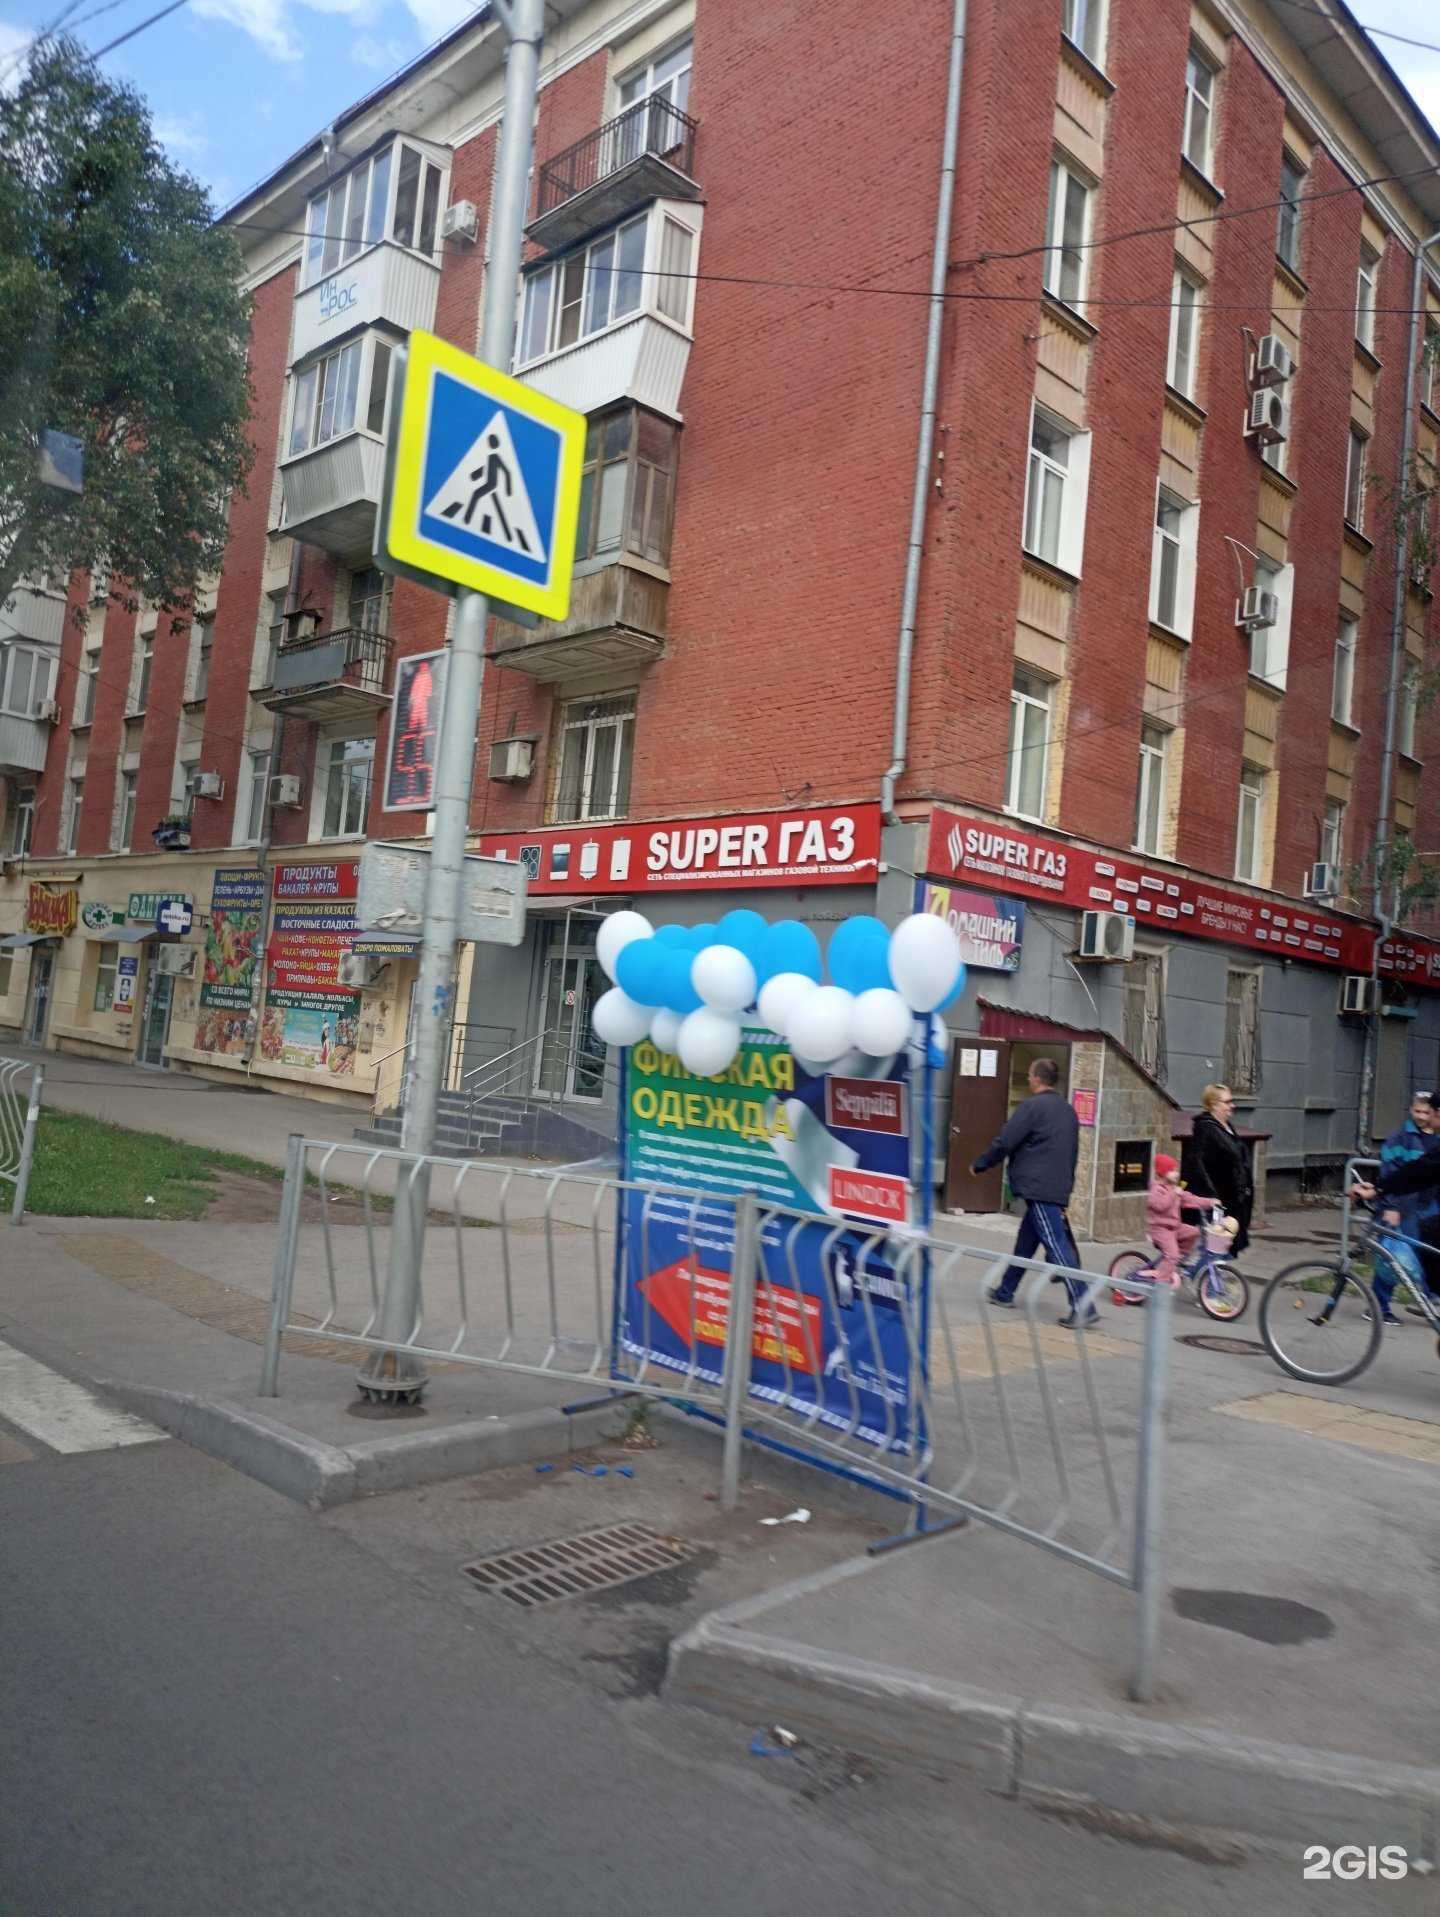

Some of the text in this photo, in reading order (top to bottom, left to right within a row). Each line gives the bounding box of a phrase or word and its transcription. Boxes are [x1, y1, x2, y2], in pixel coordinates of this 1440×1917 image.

[647, 817, 855, 871] SUPER ГАЗ
[965, 829, 1028, 868] SUPER
[1033, 847, 1067, 877] ГАЗ
[283, 866, 337, 881] ПРОДУКТЫ
[278, 882, 339, 894] БАКАЛЕЯ КРУПЫ
[276, 904, 313, 916] ПРОДУКТЫ
[281, 920, 321, 929] ВОСТОЧНЫЕ
[632, 1087, 796, 1142] ОДЕЖДА
